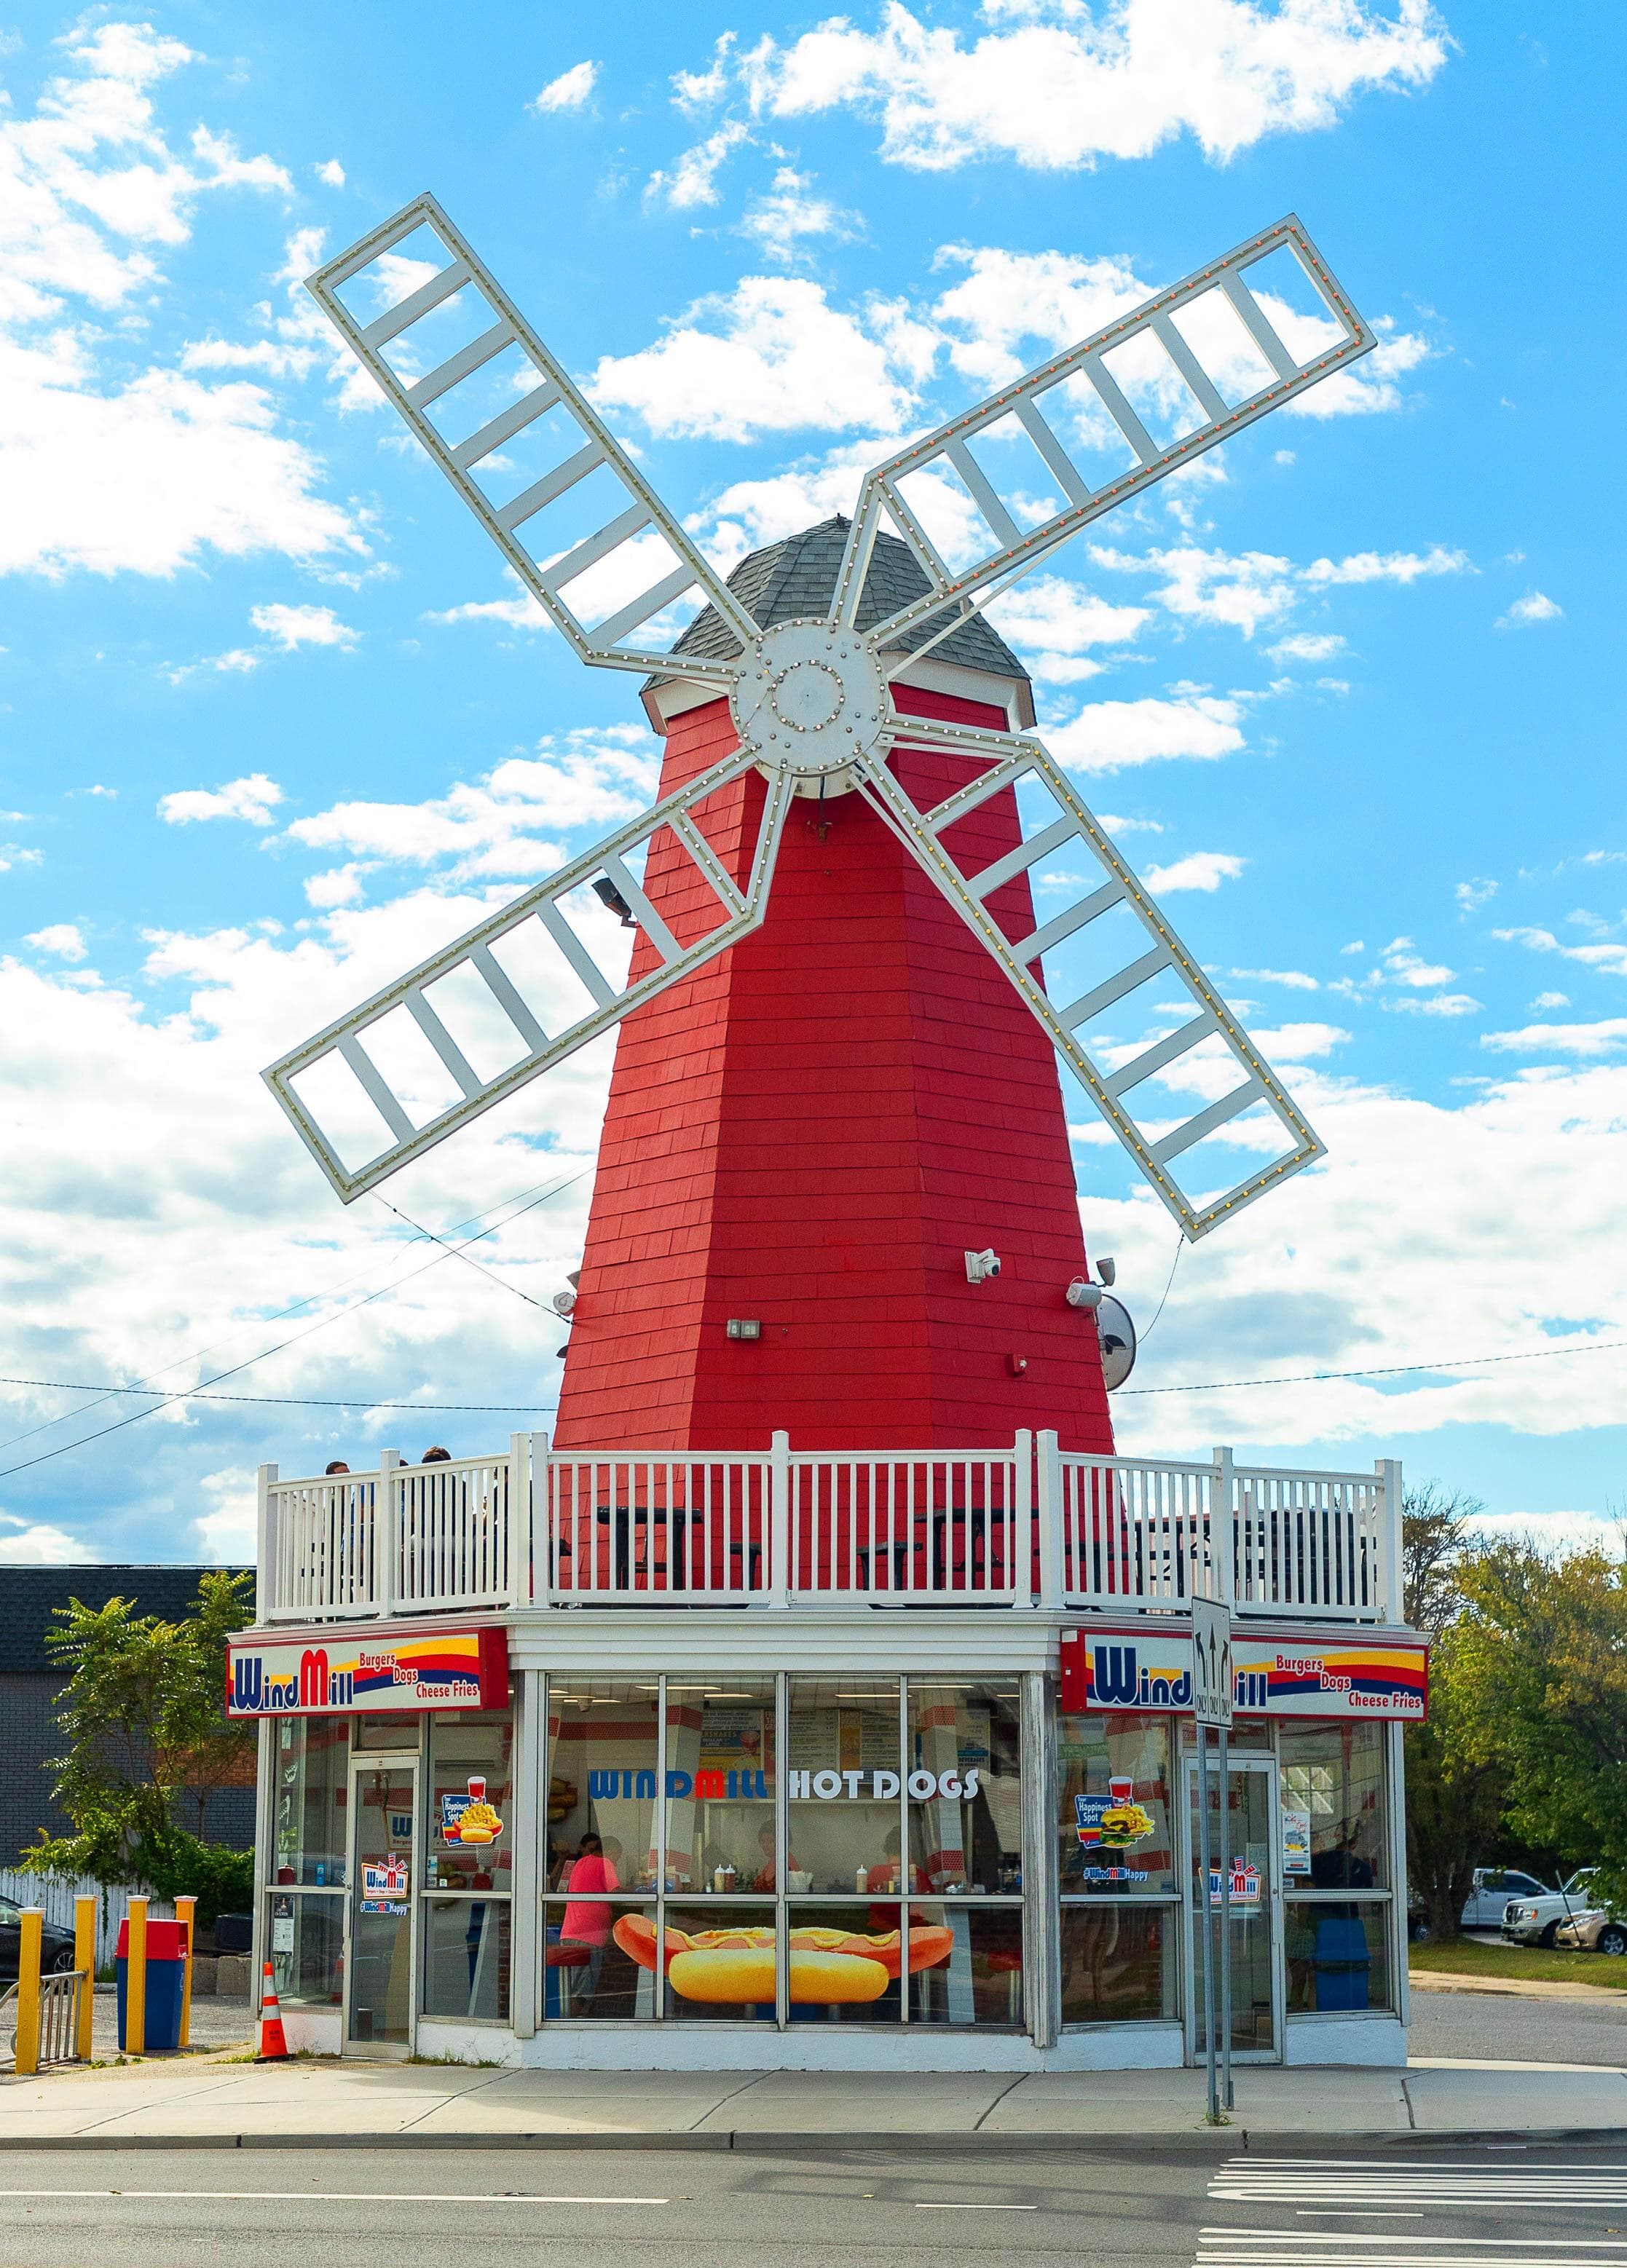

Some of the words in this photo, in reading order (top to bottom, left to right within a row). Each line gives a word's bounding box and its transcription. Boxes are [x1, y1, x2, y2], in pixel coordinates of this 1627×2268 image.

[359, 1652, 396, 1672] Burgers
[1276, 1654, 1323, 1677] Burgers
[235, 1648, 353, 1710] WindMill
[394, 1667, 418, 1686] Dogs
[1093, 1645, 1268, 1707] Windill
[1320, 1672, 1351, 1693] Dogs
[416, 1683, 450, 1699] Cheese
[453, 1680, 478, 1697] Fries
[1197, 1694, 1207, 1715] ONLY
[1209, 1696, 1219, 1715] ONLY
[1221, 1699, 1231, 1718] ONLY
[1348, 1690, 1388, 1707] Cheese
[1392, 1691, 1421, 1709] Fries
[589, 1770, 768, 1800] WINDMILL
[789, 1770, 864, 1800] HOT
[873, 1770, 980, 1800] DOGS
[444, 1801, 470, 1813] Happiness
[447, 1810, 459, 1823] Spot
[1079, 1802, 1113, 1814] Happiness
[1083, 1811, 1098, 1825] Spot
[366, 1870, 404, 1889] WindMill
[1210, 1874, 1256, 1893] WidMill
